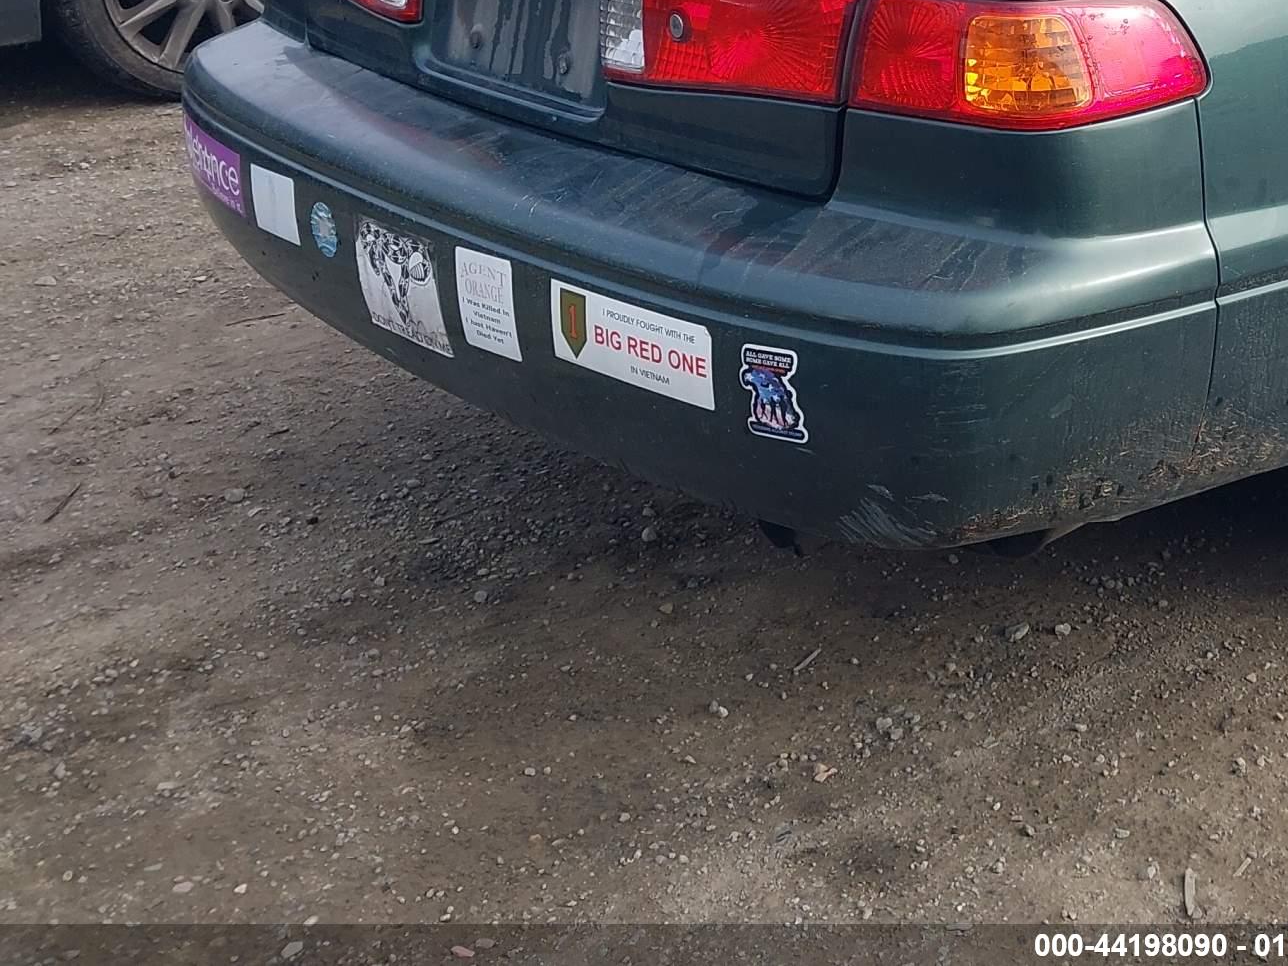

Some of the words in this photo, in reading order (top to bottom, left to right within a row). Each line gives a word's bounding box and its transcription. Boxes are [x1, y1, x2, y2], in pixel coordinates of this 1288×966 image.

[460, 262, 507, 288] AGENT
[465, 278, 504, 305] ORANGE
[467, 297, 480, 308] Was
[482, 301, 501, 315] Killed
[473, 309, 501, 325] Vietnam
[606, 310, 634, 326] PROUDLY
[636, 319, 663, 335] FOUGHT
[664, 327, 682, 340] WITH
[683, 334, 695, 344] THE
[476, 329, 492, 340] Died
[494, 335, 505, 345] Yet
[594, 324, 622, 352] BIG
[627, 335, 662, 364] RED
[668, 349, 707, 378] ONE
[746, 350, 757, 358] ALL
[758, 352, 773, 361] GAVE
[774, 354, 792, 364] SOME
[762, 359, 777, 367] GAVE
[631, 365, 639, 375] IN
[639, 368, 670, 386] VIETNAM
